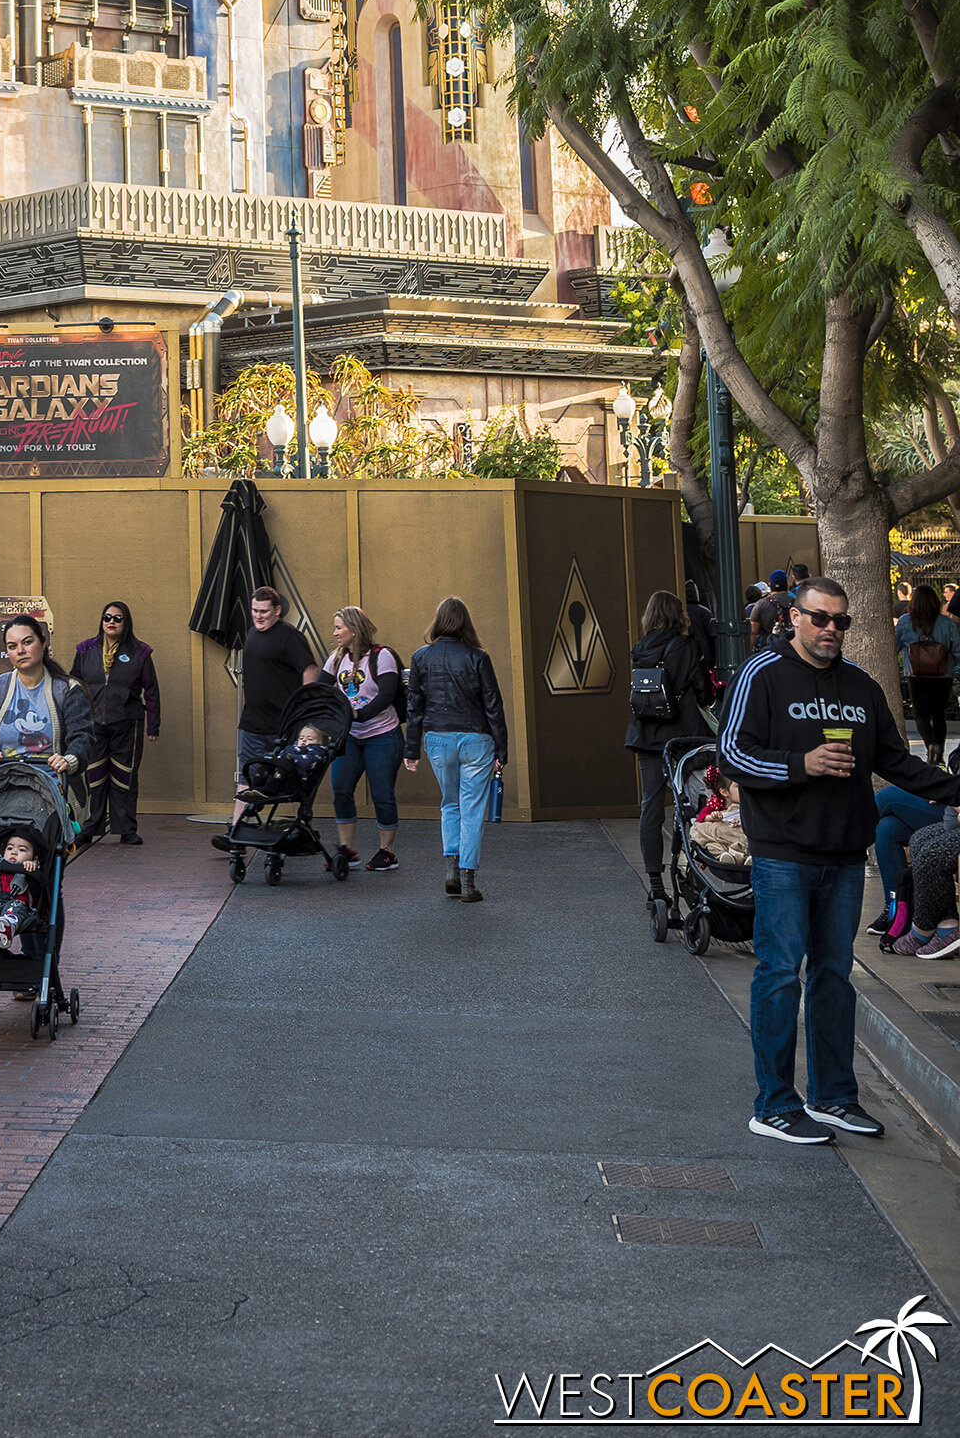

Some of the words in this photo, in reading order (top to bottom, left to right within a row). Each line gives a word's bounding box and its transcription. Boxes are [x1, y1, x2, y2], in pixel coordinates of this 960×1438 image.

[29, 359, 42, 368] AT
[44, 359, 62, 367] THE
[93, 357, 148, 367] COLLECTION
[0, 444, 20, 453] NOW
[24, 444, 43, 453] FOR
[66, 443, 97, 452] TOURS
[788, 697, 867, 724] adidas
